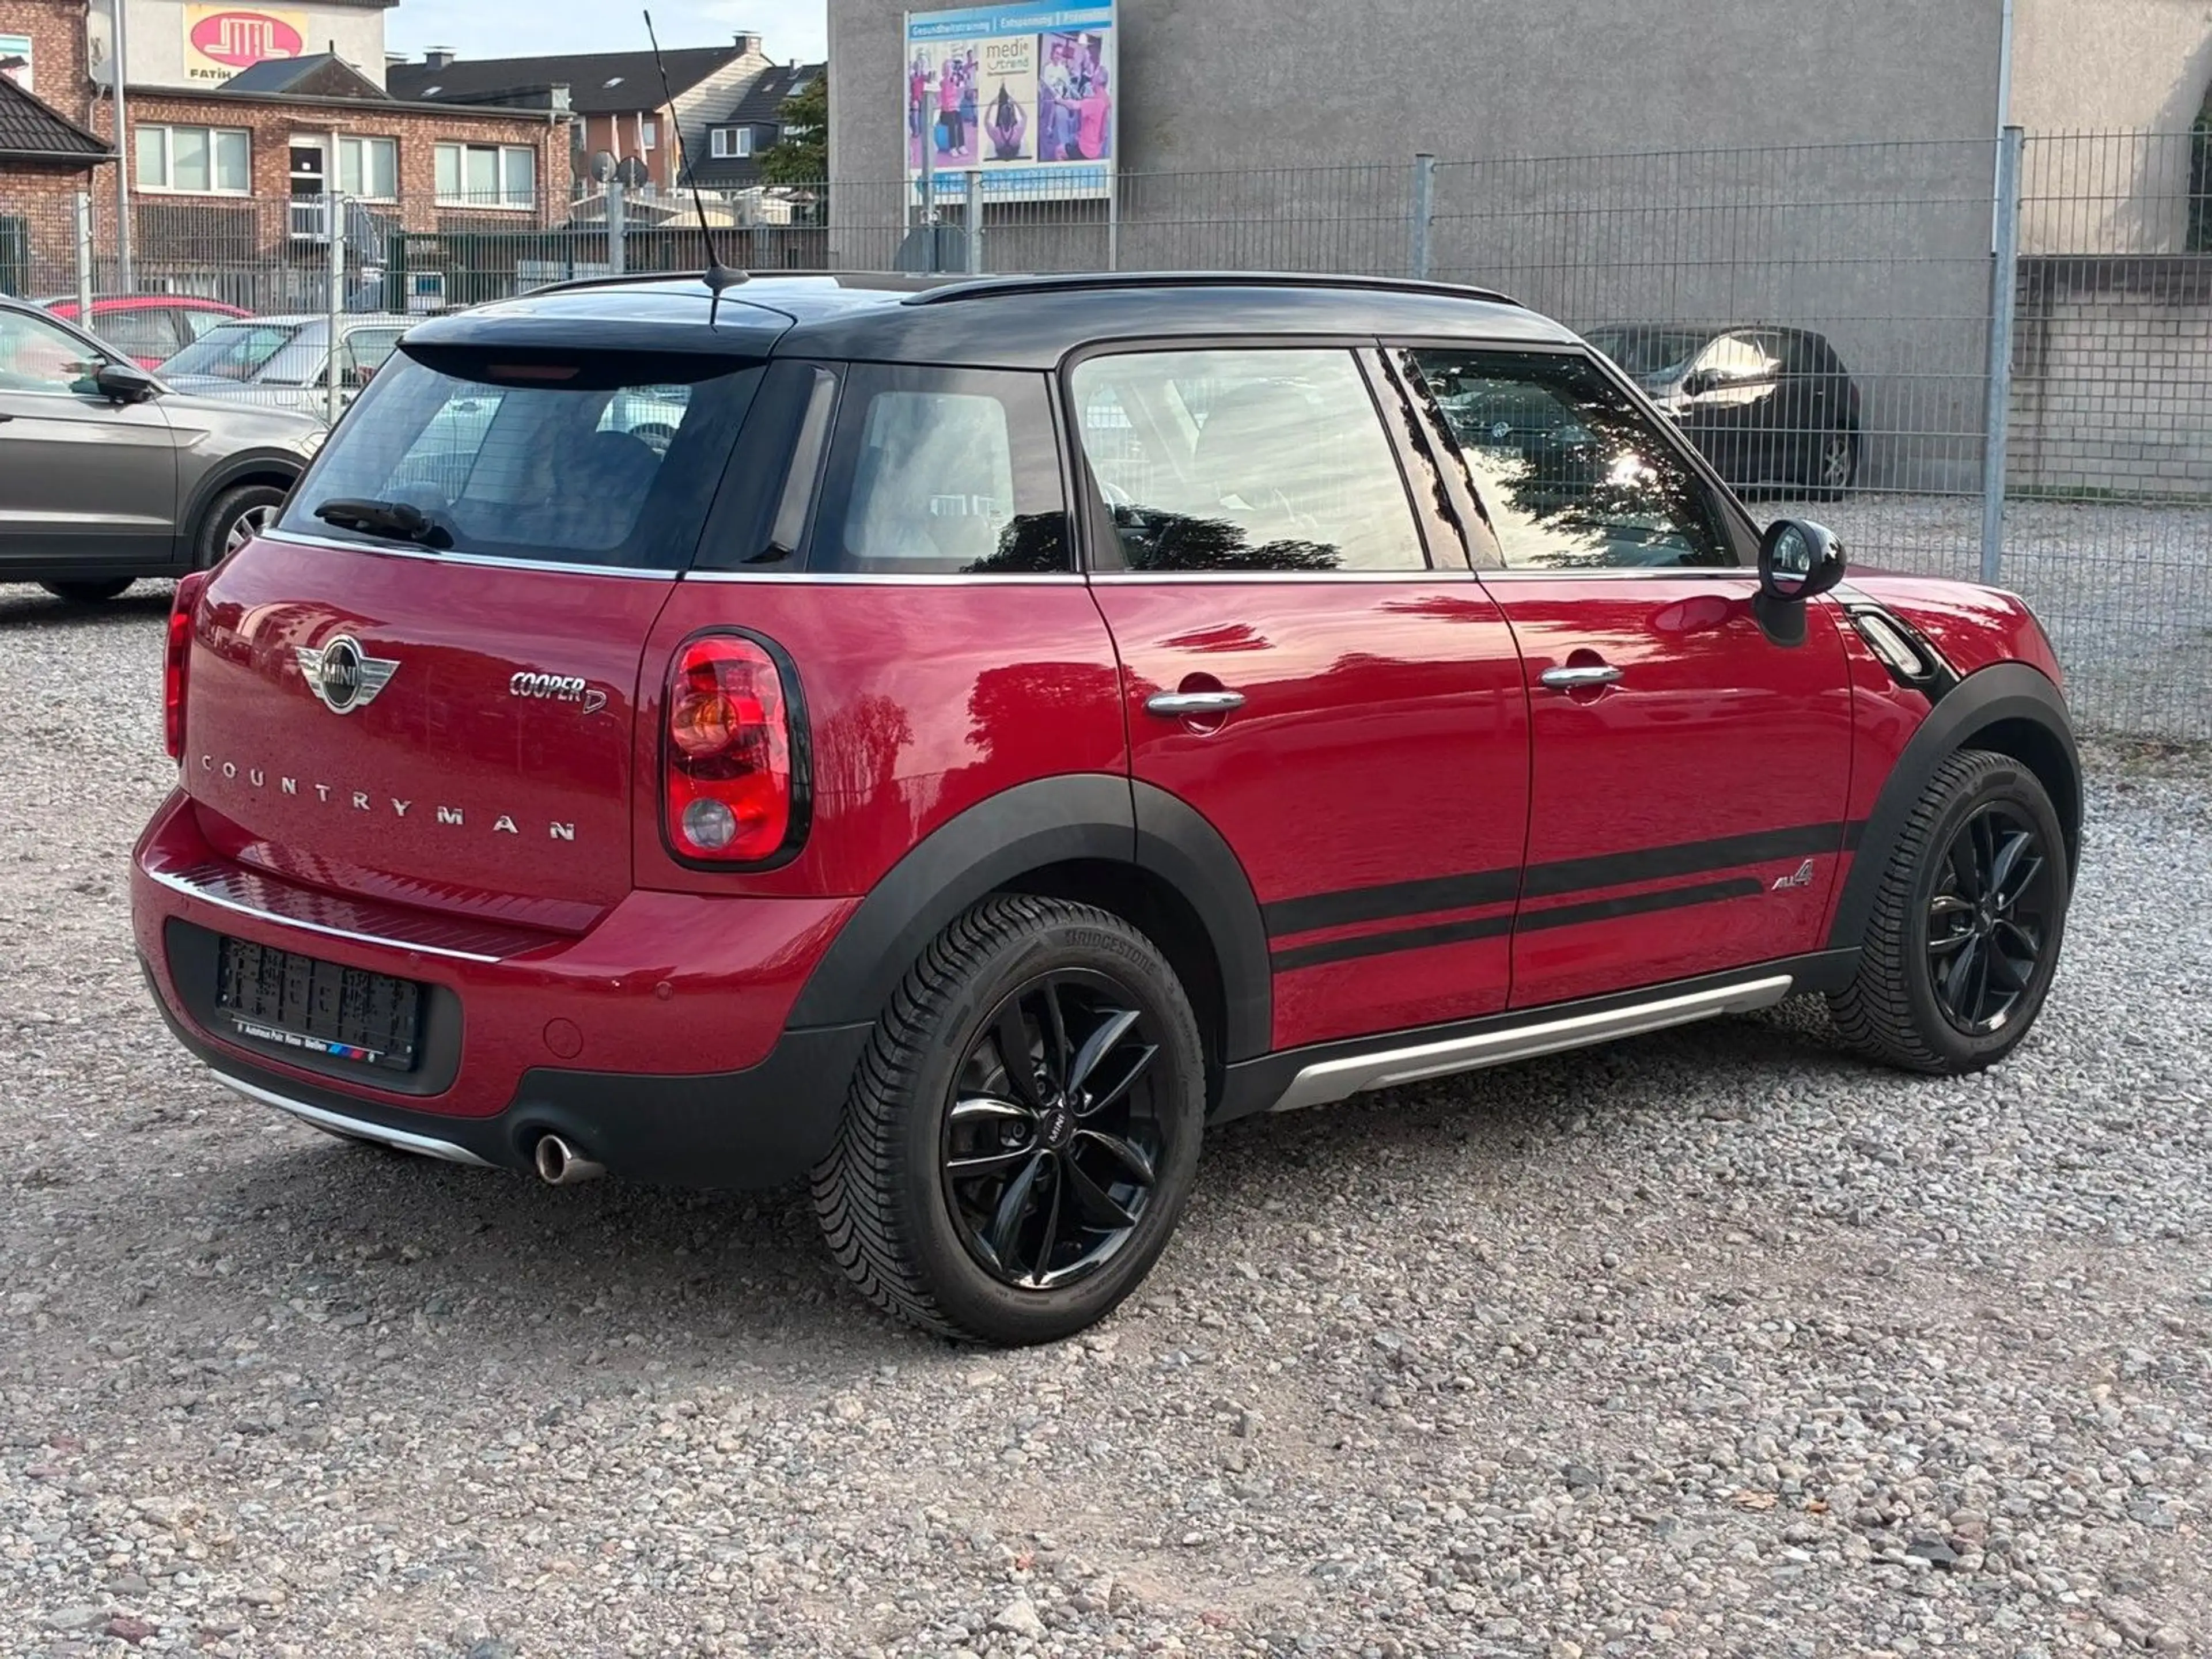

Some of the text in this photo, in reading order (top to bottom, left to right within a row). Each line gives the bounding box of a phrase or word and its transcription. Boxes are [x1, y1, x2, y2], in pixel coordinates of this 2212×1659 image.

[324, 663, 357, 685] MINI
[509, 671, 607, 715] COOPER D
[202, 754, 575, 841] COUNTRYMAN
[1065, 929, 1157, 976] BRIDGESTONE
[1048, 1113, 1066, 1142] MINI
